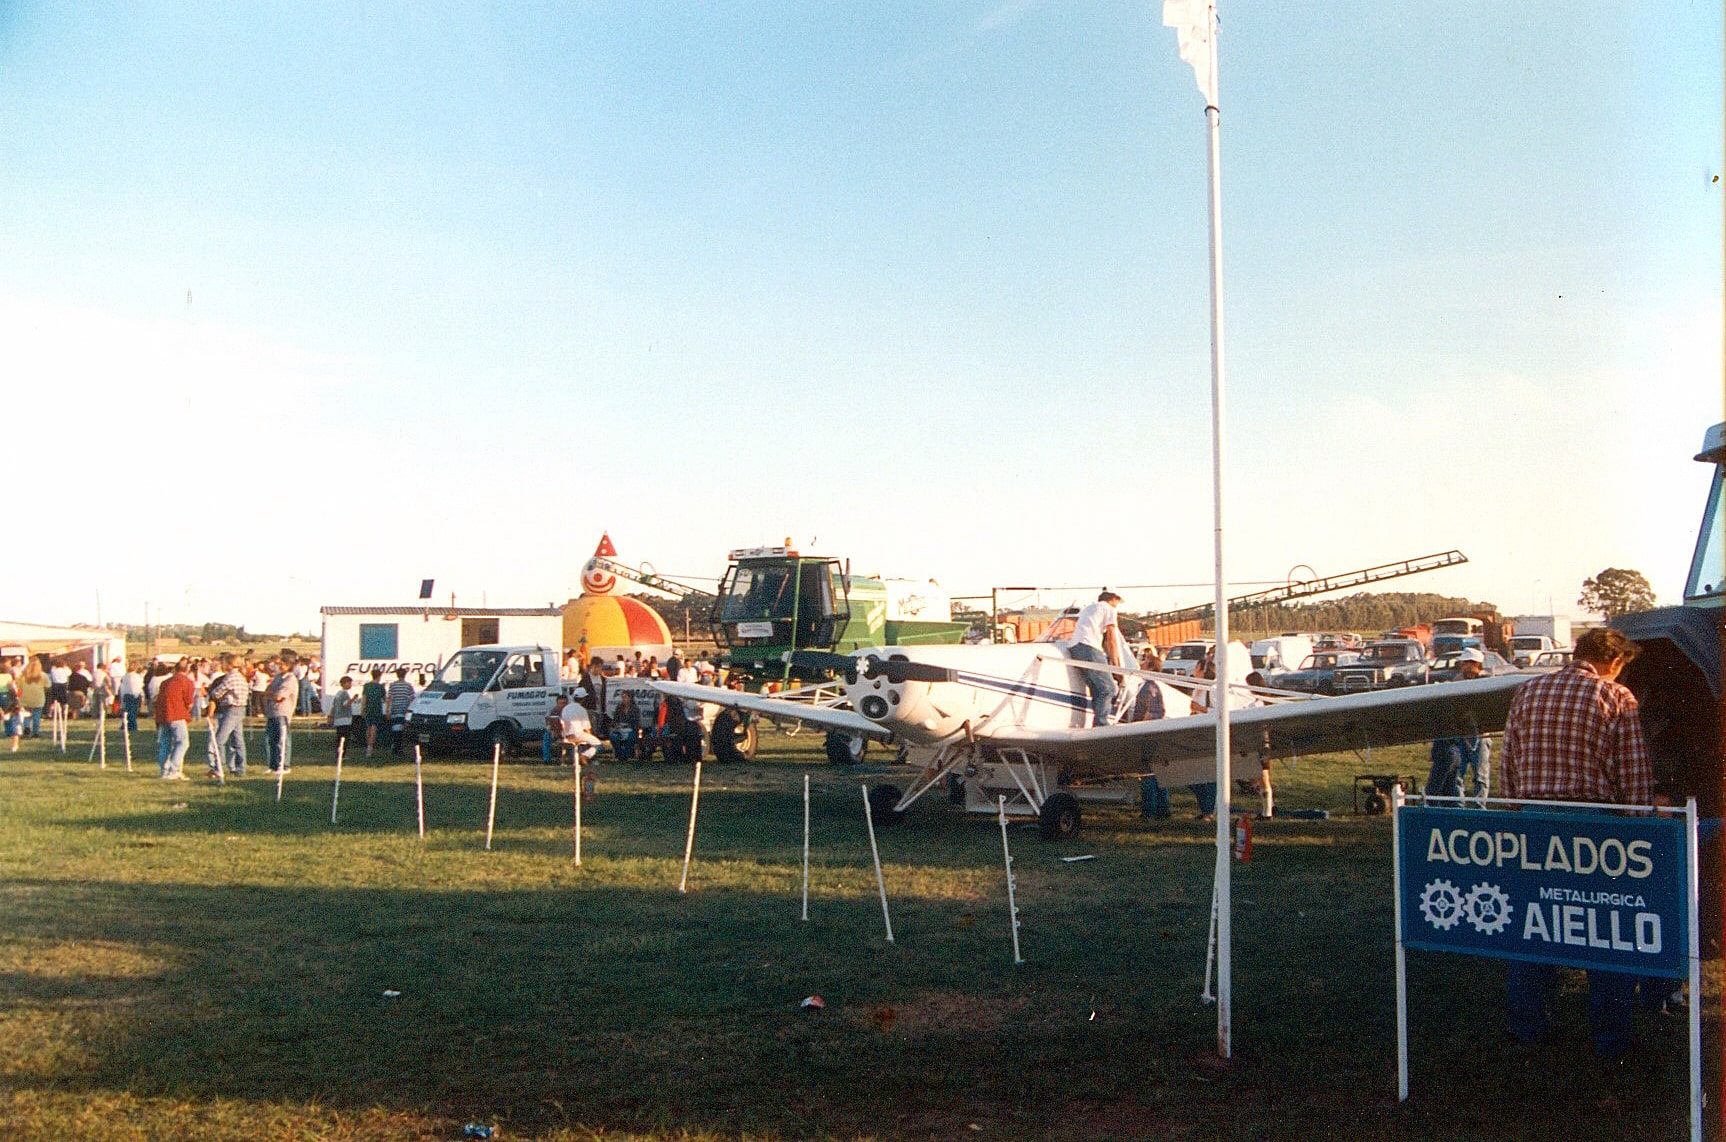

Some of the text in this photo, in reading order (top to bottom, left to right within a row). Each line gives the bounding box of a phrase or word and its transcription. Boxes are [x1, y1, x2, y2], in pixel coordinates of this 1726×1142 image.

[1427, 828, 1653, 879] ACOPLADOS
[1540, 887, 1646, 908] METALURGICA
[1523, 902, 1662, 953] AIELLO
